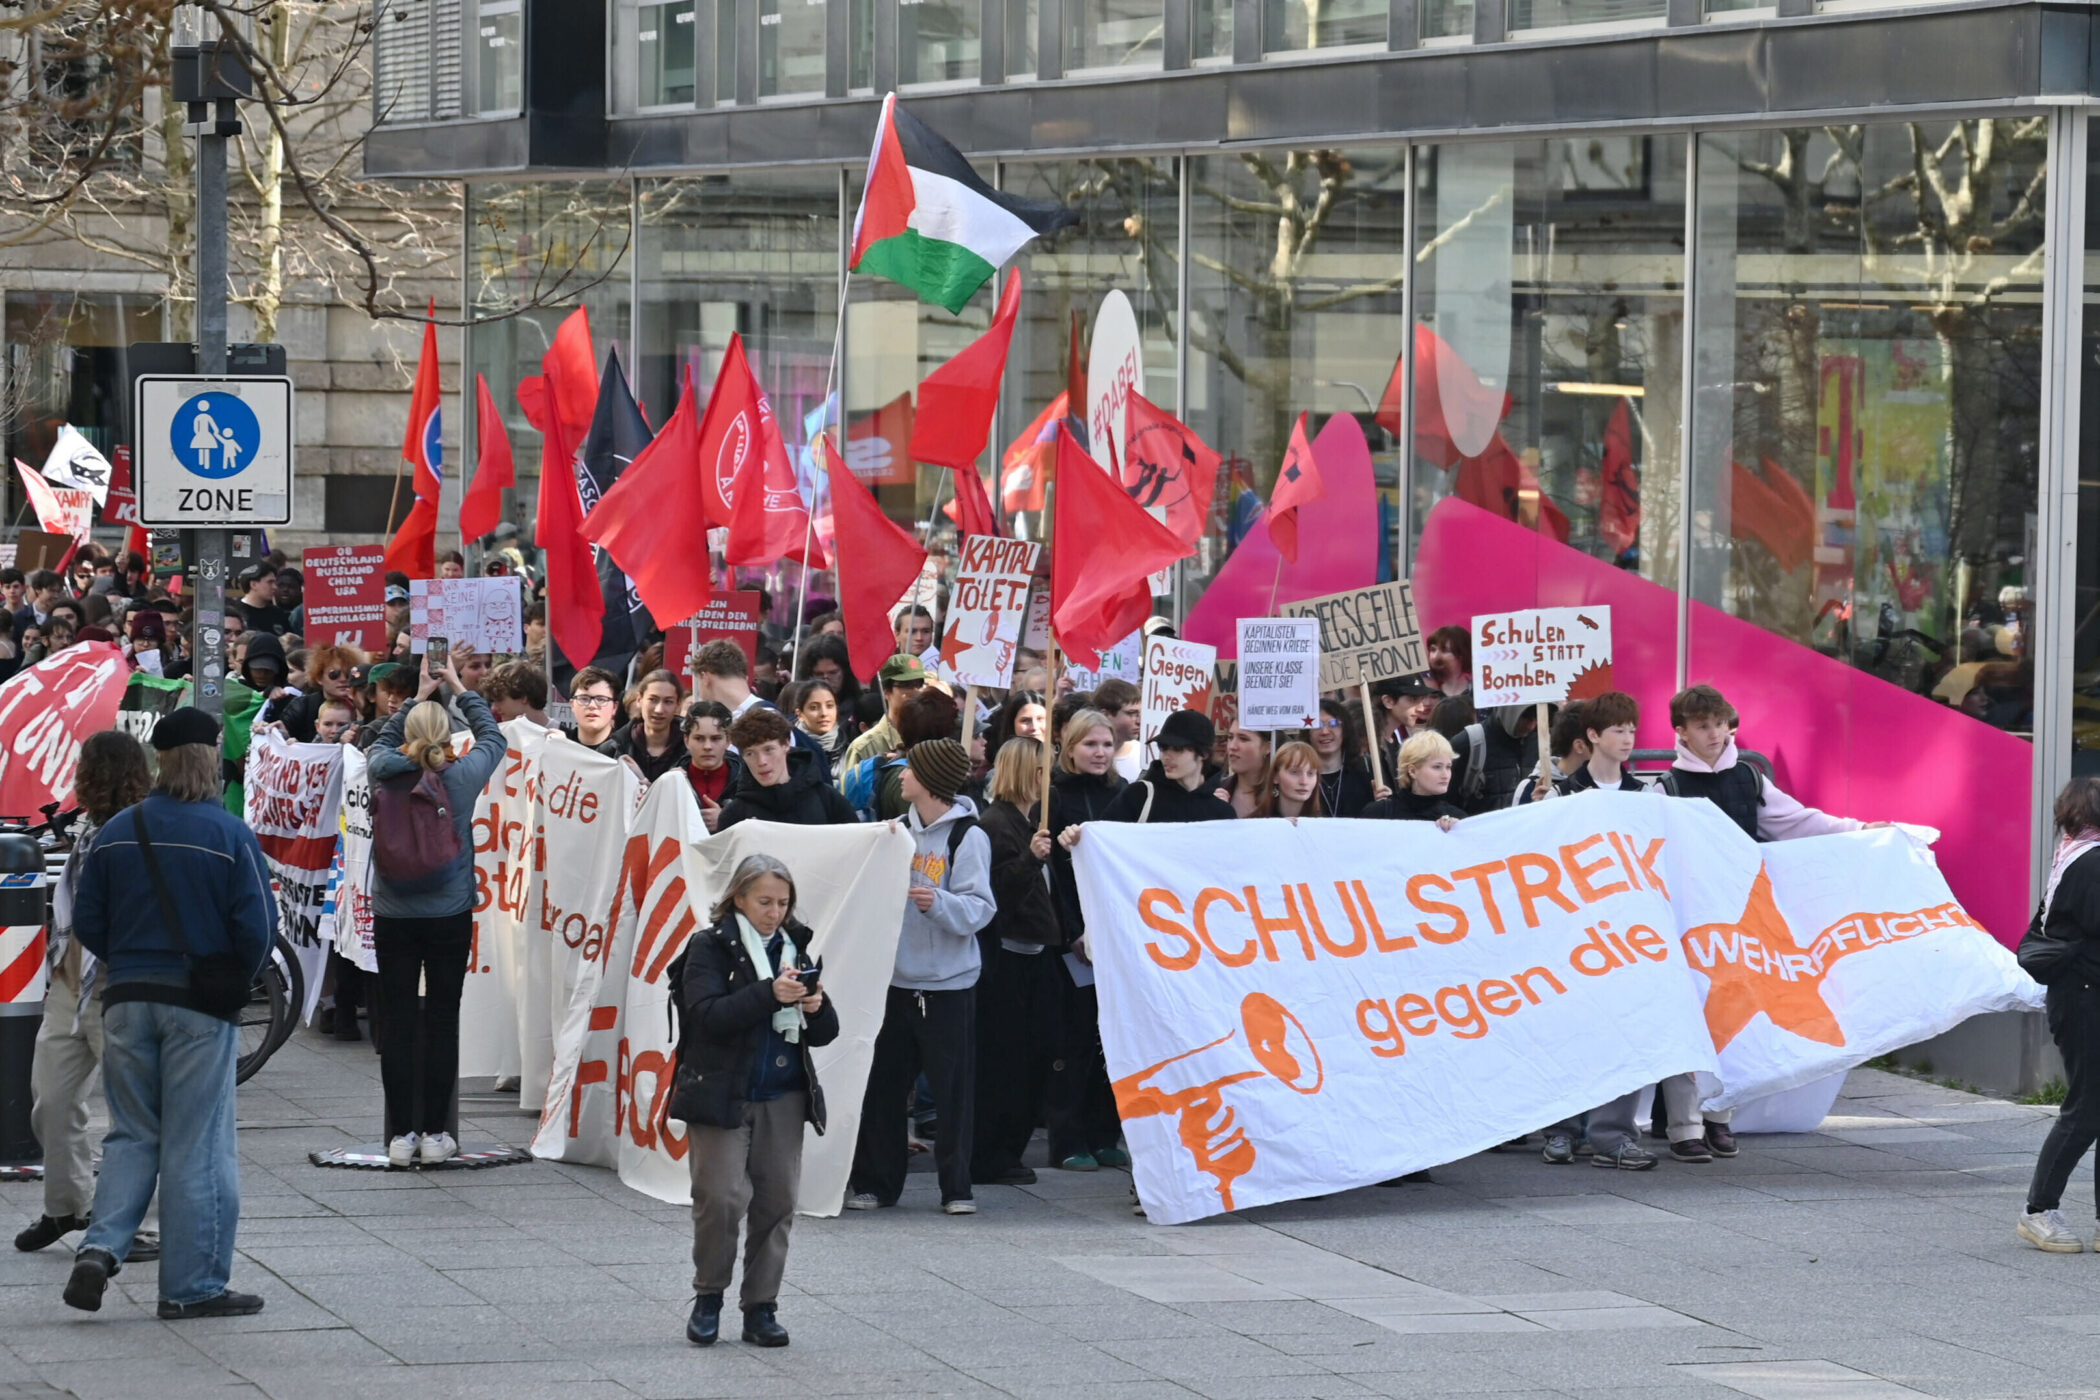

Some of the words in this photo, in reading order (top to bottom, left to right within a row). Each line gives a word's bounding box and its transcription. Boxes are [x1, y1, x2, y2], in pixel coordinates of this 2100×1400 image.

[1094, 345, 1138, 446] #DABEI
[178, 489, 253, 511] ZONE
[305, 555, 384, 568] DEUTSCHLAND
[962, 537, 1035, 576] KAPITAL
[316, 565, 375, 577] RUSSLAND
[328, 576, 364, 587] CHINA
[335, 586, 358, 597] USA
[308, 603, 385, 616] IMPERIALISMUS
[704, 600, 728, 609] EIN
[310, 613, 384, 625] ZERSCHLAGEN!
[727, 611, 748, 620] DEN
[1289, 584, 1420, 653] IEGSGEILE
[334, 630, 362, 648] KJ
[1245, 625, 1296, 639] KAPITALISTEN
[1245, 640, 1282, 653] BEGINNEN
[1533, 644, 1585, 662] STATT
[1149, 642, 1205, 686] Gegen
[1245, 661, 1274, 675] UNSERE
[1275, 661, 1304, 674] KLASSE
[1356, 640, 1421, 678] FRONT
[1245, 675, 1278, 689] BEENDET
[1279, 675, 1294, 688] SIE!
[1482, 663, 1556, 690] Bomben
[1147, 678, 1180, 713] Ihre
[549, 769, 599, 824] die
[1137, 830, 1671, 972] SCHULSTREIK
[1688, 905, 1972, 982] WEHRPFLICHT
[1355, 965, 1568, 1058] gegen
[1569, 920, 1668, 976] die
